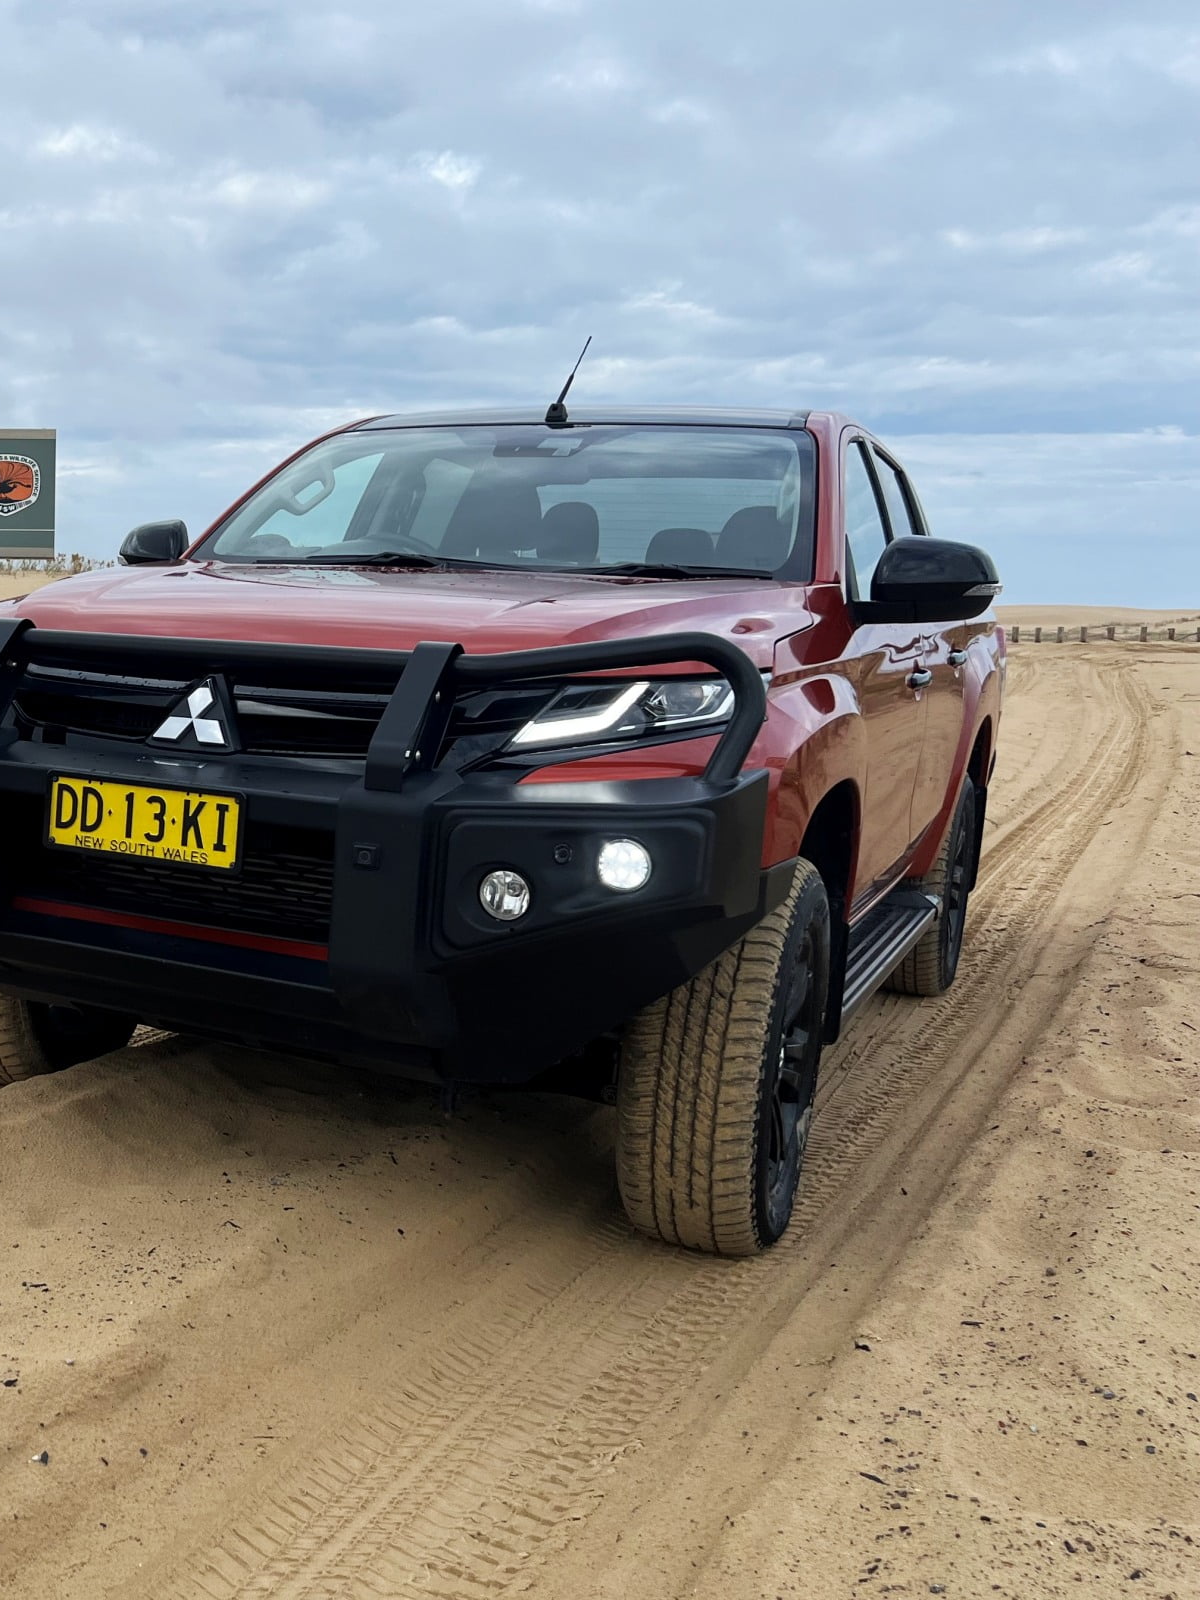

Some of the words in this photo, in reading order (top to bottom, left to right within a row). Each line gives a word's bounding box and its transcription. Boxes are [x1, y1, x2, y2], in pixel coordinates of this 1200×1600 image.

[9, 455, 37, 468] WILDLIFE
[75, 835, 104, 849] NEW
[110, 840, 155, 856] SOUTH
[162, 847, 208, 864] WALES
